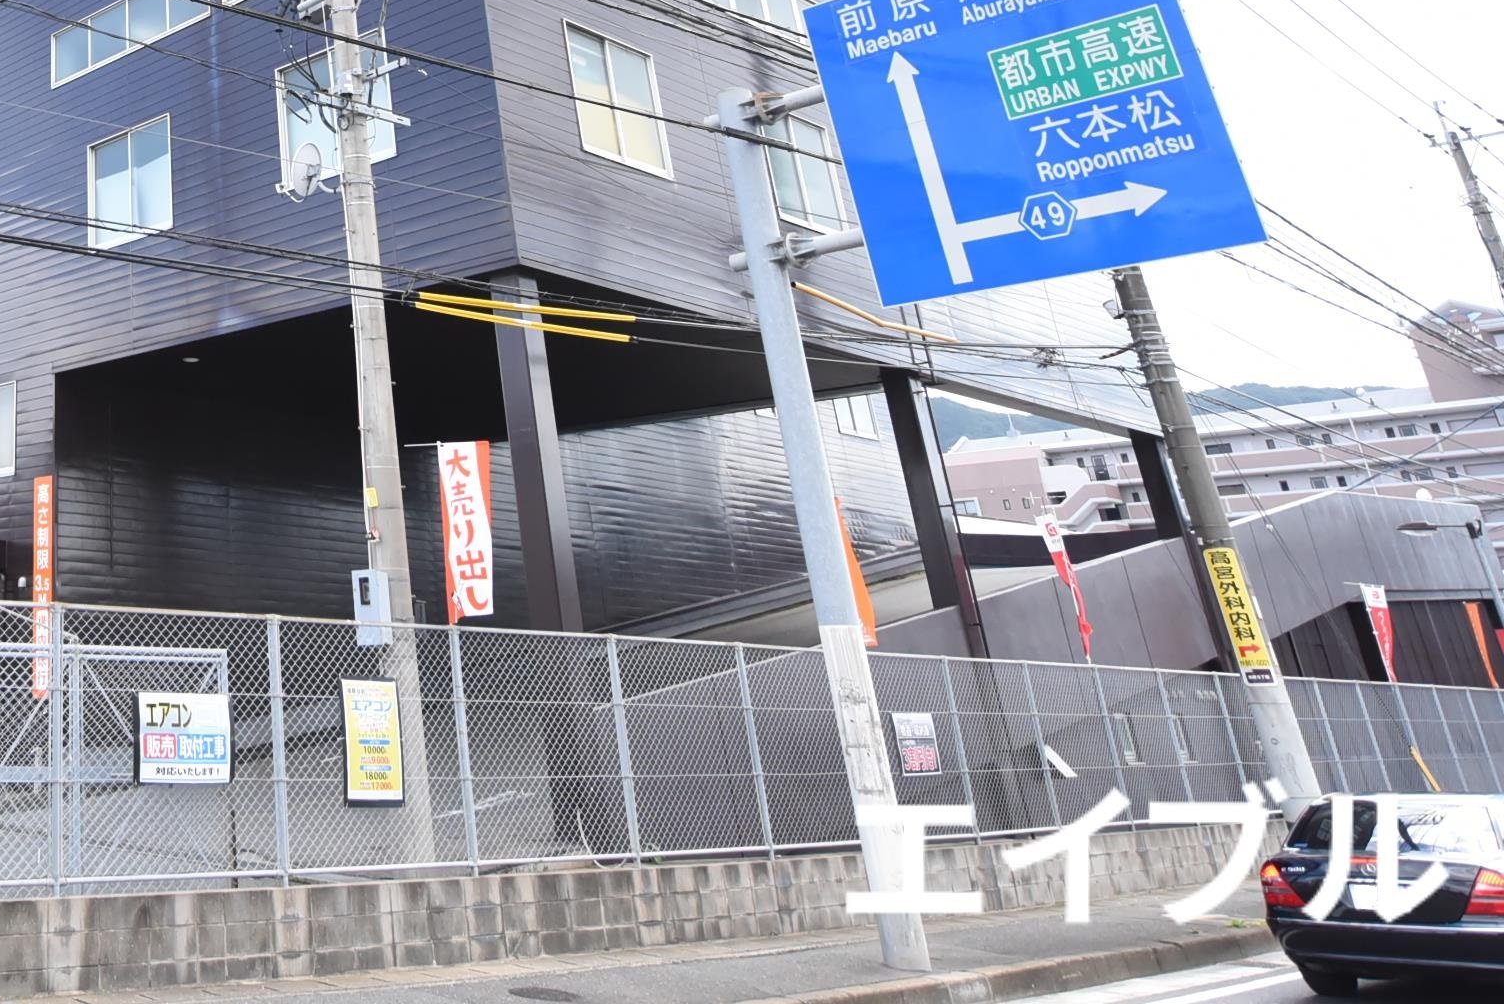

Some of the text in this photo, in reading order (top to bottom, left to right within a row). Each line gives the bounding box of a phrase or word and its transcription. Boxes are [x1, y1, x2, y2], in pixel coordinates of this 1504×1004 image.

[847, 19, 937, 60] Maebaru
[997, 15, 1165, 90] 都市高速
[1011, 55, 1170, 115] URBAN EXPWY
[1029, 90, 1183, 158] 六本松
[1036, 133, 1195, 183] Ropponmatsu
[1030, 203, 1065, 230] 49
[446, 449, 489, 611] 大売り出し
[1208, 551, 1256, 641] 高宮外科内科
[145, 702, 193, 728] エアコン
[352, 699, 392, 713] エアコン
[146, 735, 225, 759] 販売 取付工事
